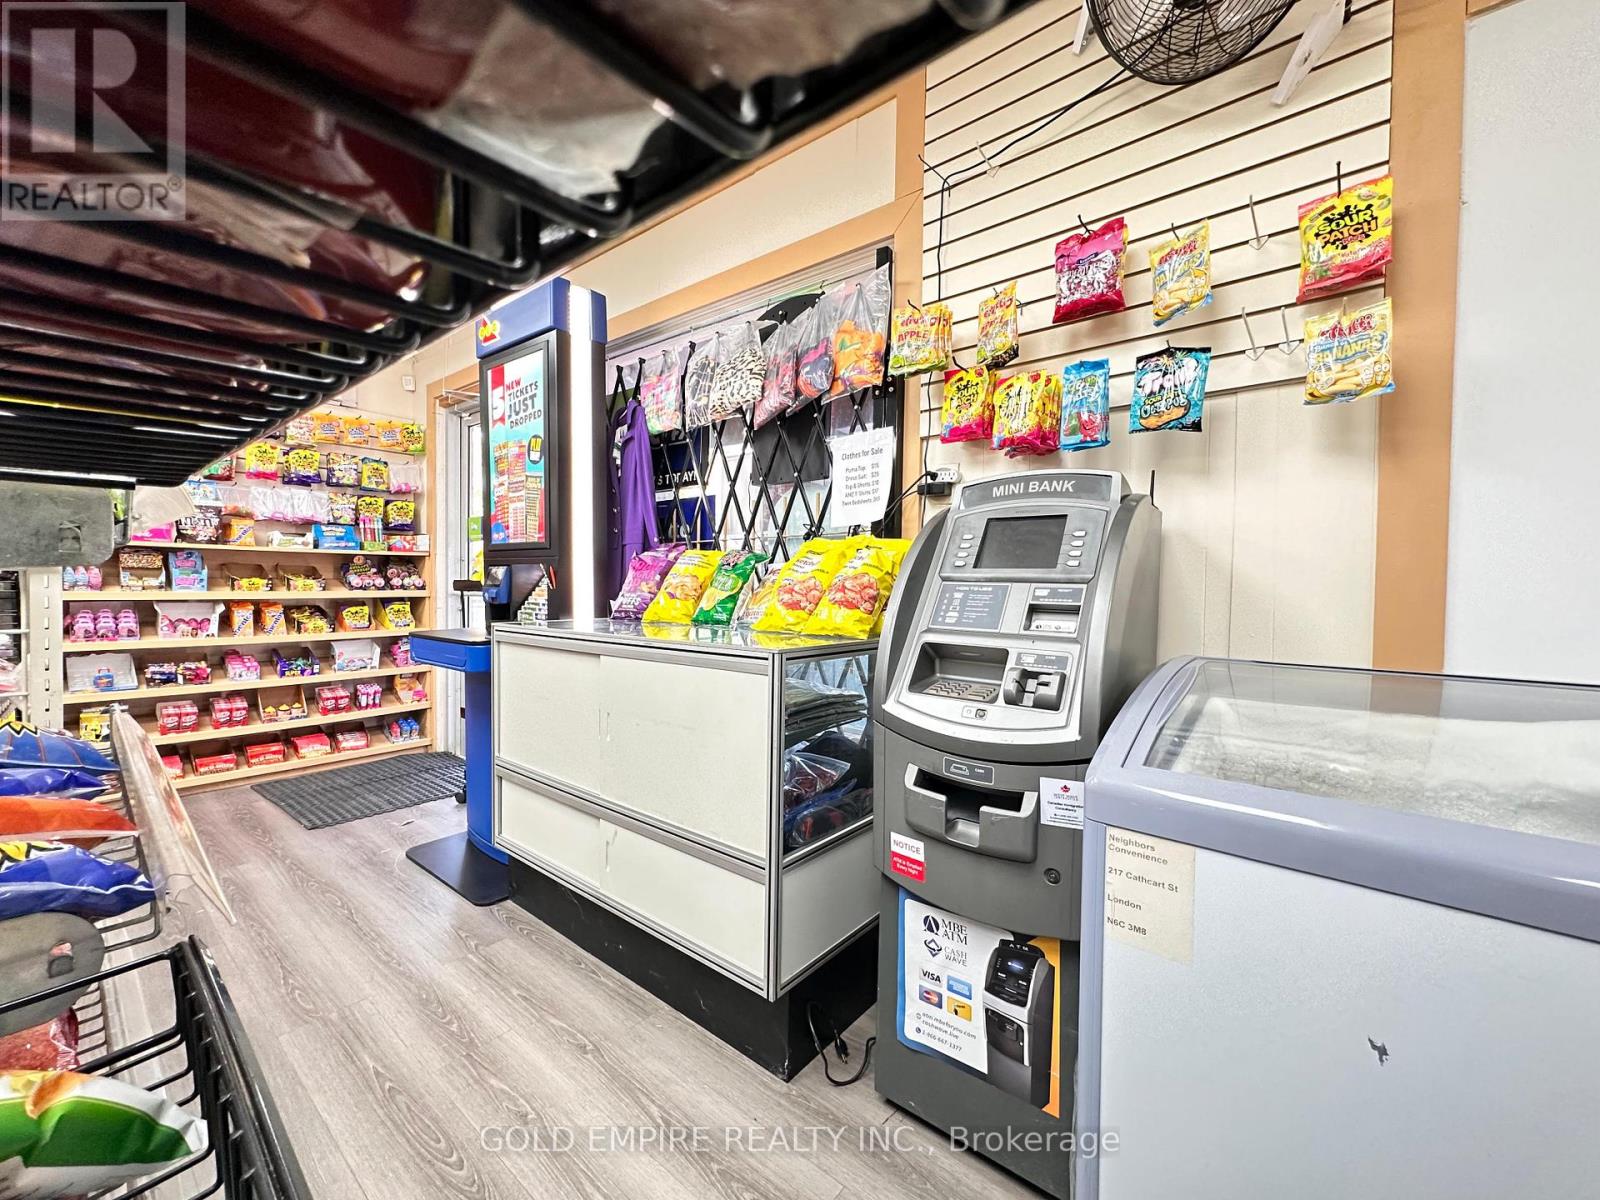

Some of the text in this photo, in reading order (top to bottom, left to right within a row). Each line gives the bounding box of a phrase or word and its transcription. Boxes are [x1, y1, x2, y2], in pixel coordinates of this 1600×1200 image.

[1318, 209, 1372, 234] SOUR
[1317, 218, 1377, 244] PATCH
[898, 330, 929, 342] APPLE
[506, 378, 521, 392] NEW
[508, 381, 539, 402] TICKETS
[508, 393, 537, 418] JUST
[1144, 395, 1163, 406] SOUR
[510, 410, 542, 429] DROPPED
[841, 447, 883, 461] Clothes for Sale
[992, 480, 1076, 498] MINI BANK
[893, 839, 921, 855] NOTICE
[1108, 833, 1156, 852] Neighbors
[1108, 843, 1169, 865] Convenience
[1108, 866, 1179, 893] 217 Cathcart St
[1107, 893, 1142, 911] London
[941, 918, 967, 935] MBE
[1107, 916, 1147, 936] N6C 3M8
[941, 929, 968, 945] ATM
[944, 946, 967, 960] CASH
[944, 954, 967, 967] WAVE
[921, 968, 942, 984] VISA
